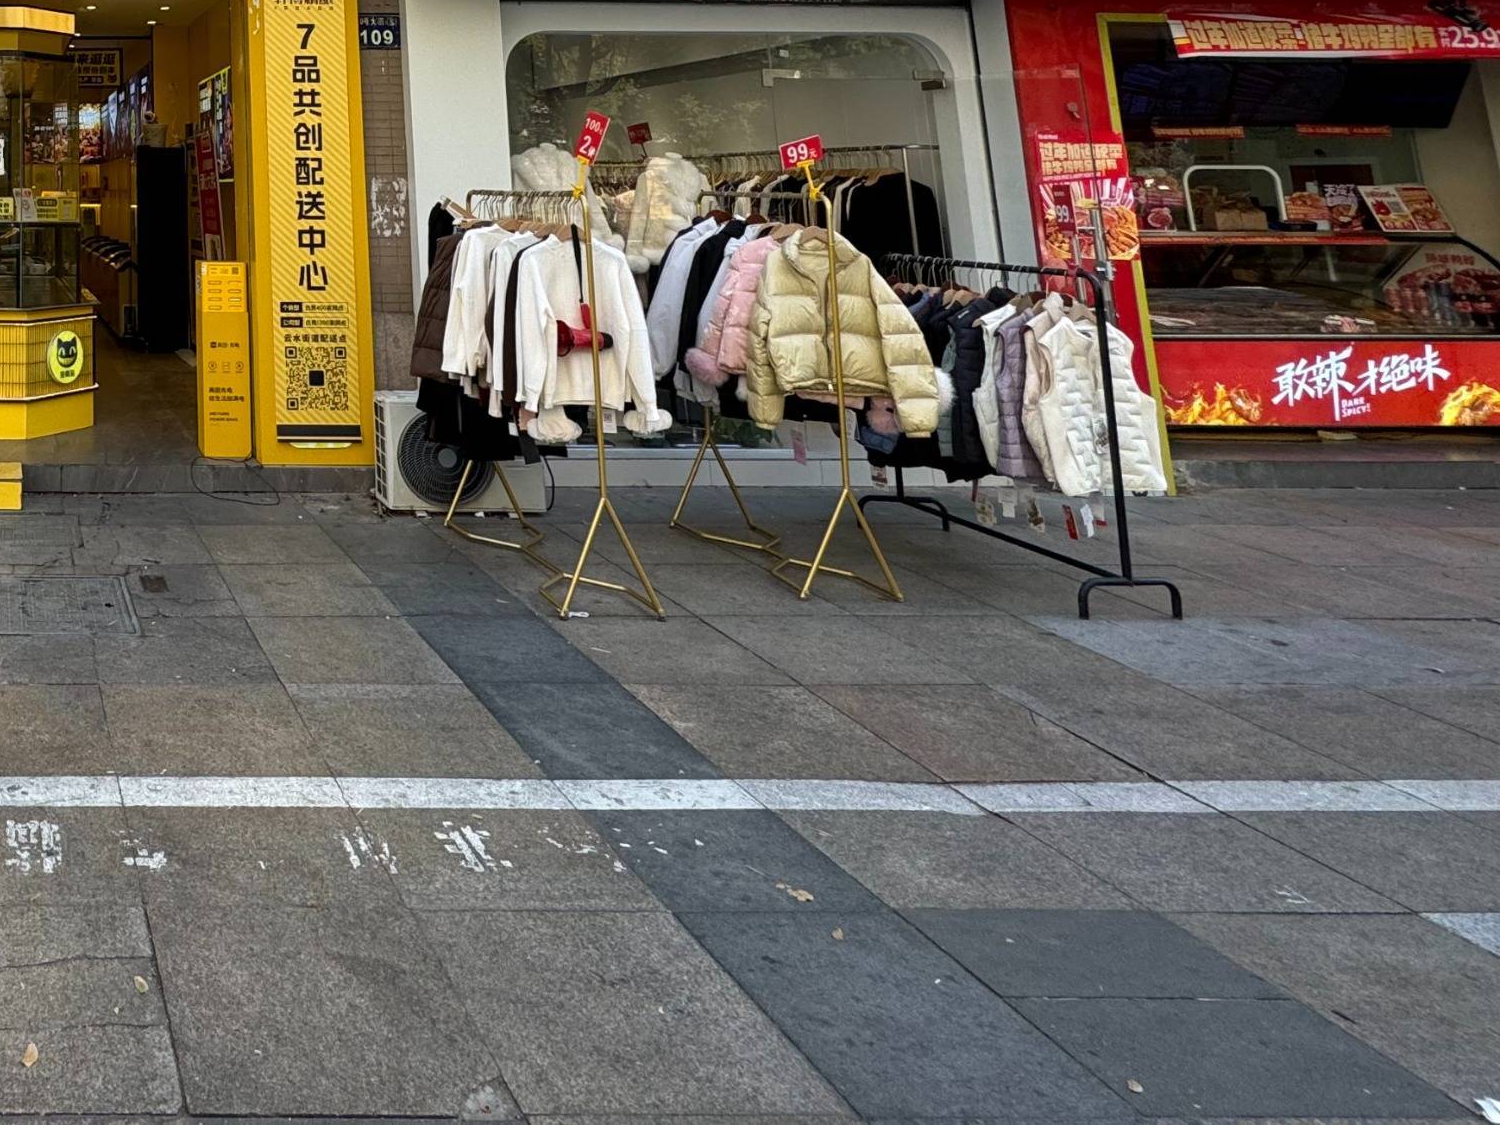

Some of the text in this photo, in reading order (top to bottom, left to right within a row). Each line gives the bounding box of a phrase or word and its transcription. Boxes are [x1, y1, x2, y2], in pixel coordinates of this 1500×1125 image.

[360, 29, 394, 45] 109
[293, 23, 329, 292] 7品共创配送中心
[787, 143, 819, 164] 99元
